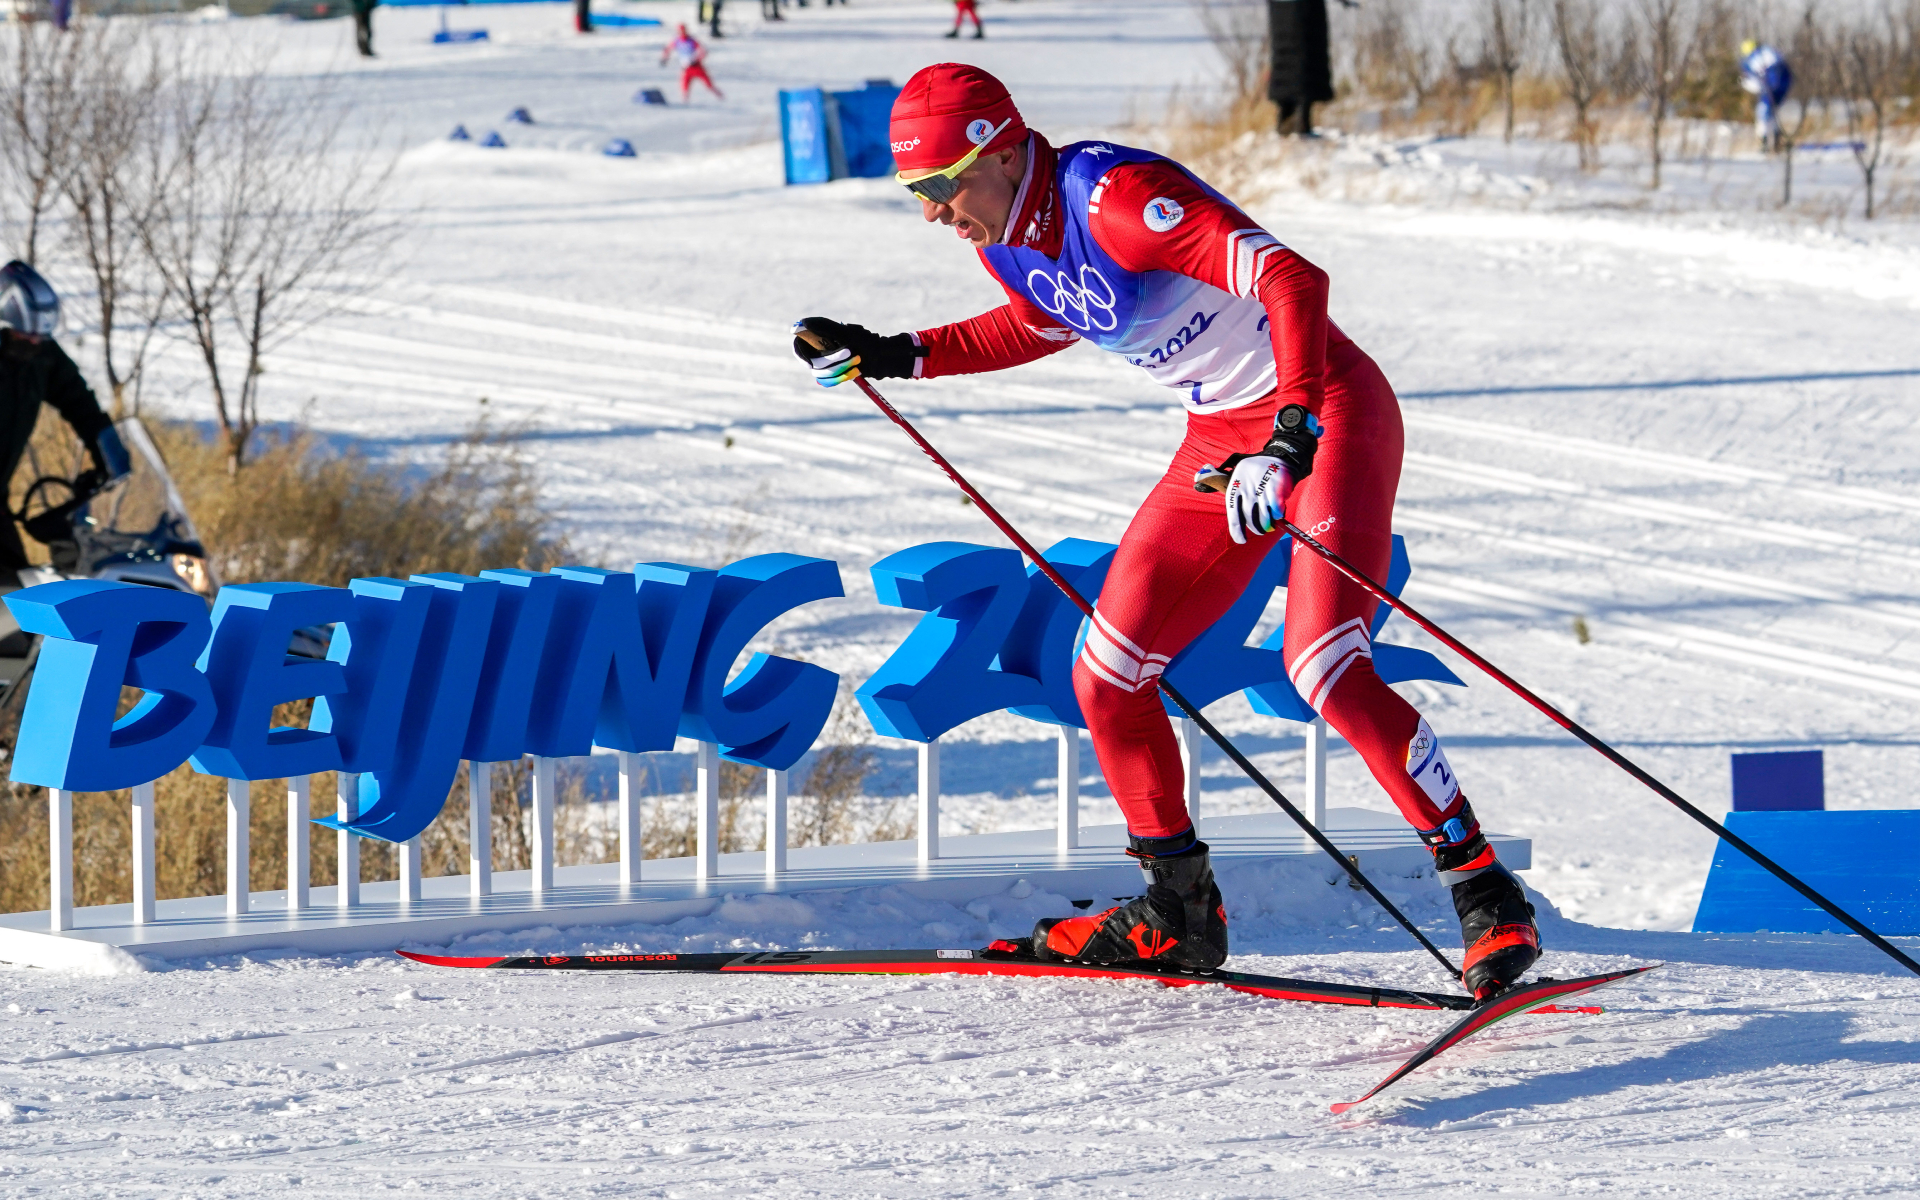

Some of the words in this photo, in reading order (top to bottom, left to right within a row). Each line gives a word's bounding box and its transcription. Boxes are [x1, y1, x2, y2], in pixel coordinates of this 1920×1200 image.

[1150, 311, 1220, 363] 2022
[2, 552, 845, 843] BEIJING
[1433, 761, 1451, 786] 2
[585, 954, 677, 963] ROSSIGNOL
